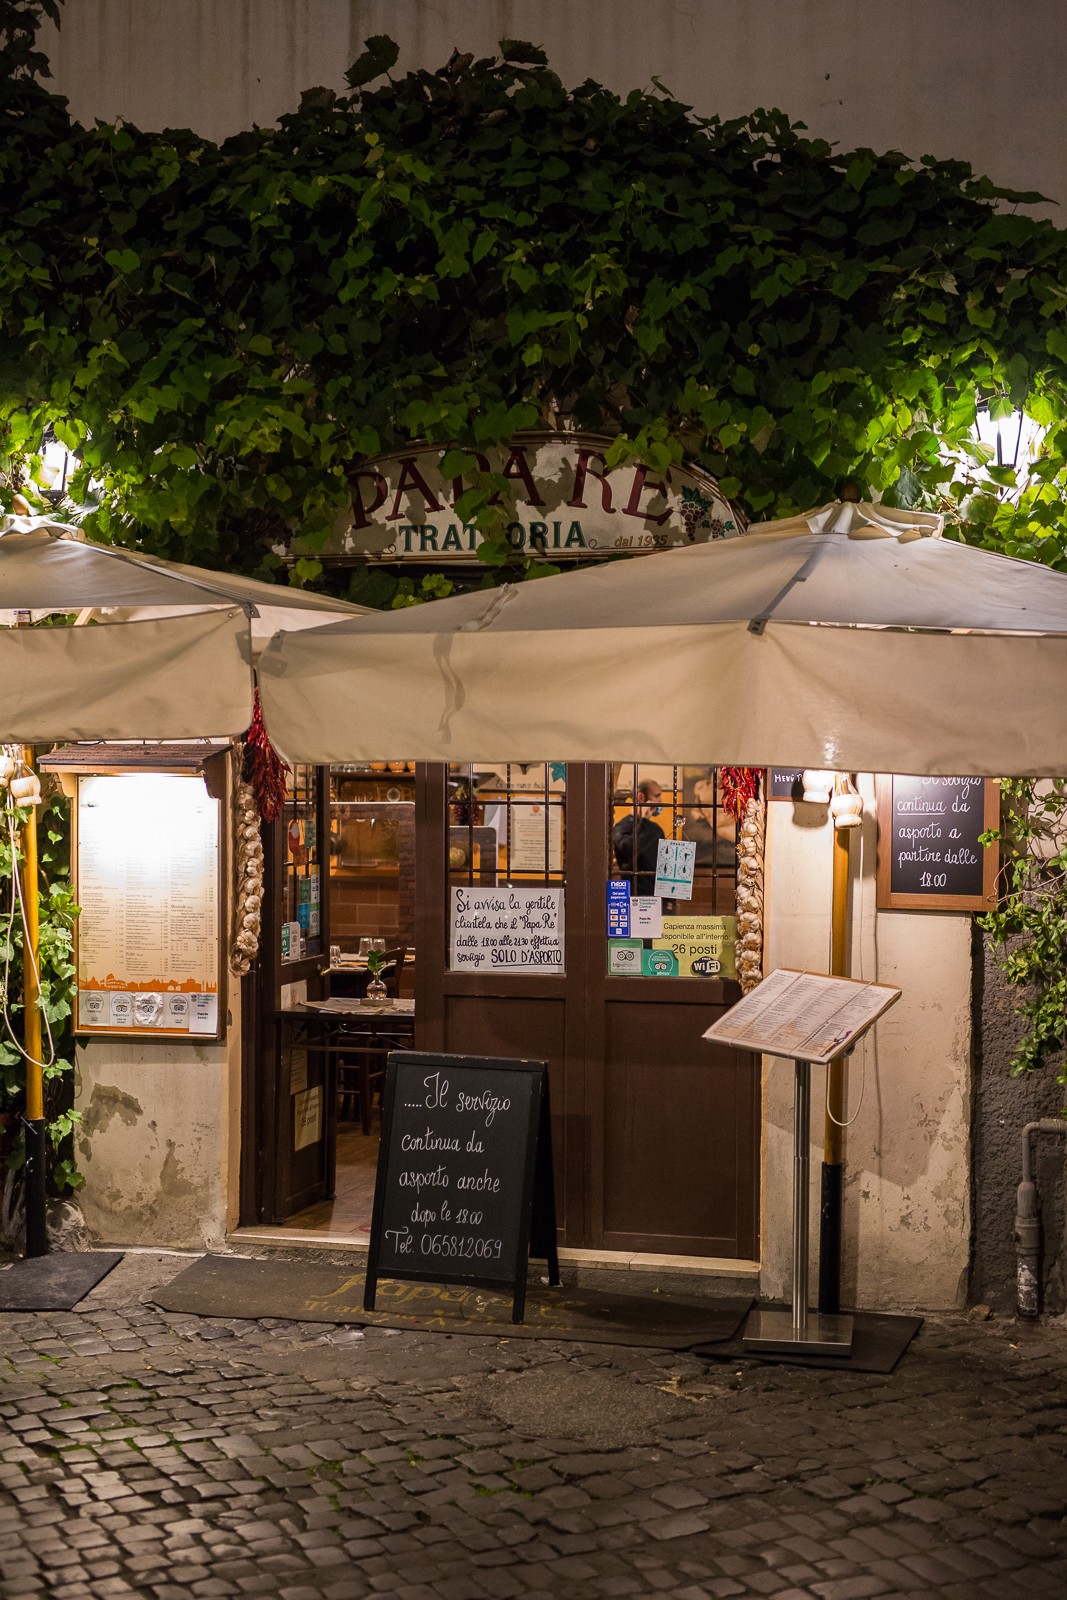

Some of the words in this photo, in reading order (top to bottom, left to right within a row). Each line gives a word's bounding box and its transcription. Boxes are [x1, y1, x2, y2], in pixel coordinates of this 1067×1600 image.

[398, 520, 590, 553] TRATORIA
[615, 535, 633, 547] dal
[637, 534, 668, 547] 1935
[896, 796, 947, 812] continua
[951, 795, 971, 813] da
[898, 822, 942, 848] asporto
[948, 827, 962, 840] a
[898, 846, 941, 869] partire
[944, 848, 978, 865] dalle
[456, 889, 471, 913] Si
[474, 896, 506, 911] avvisa
[509, 893, 521, 910] la
[526, 895, 556, 915] gentile
[455, 915, 492, 929] clientela
[495, 917, 508, 929] che
[510, 917, 518, 929] il
[663, 922, 695, 930] Capienza
[456, 934, 478, 947] dalle
[498, 934, 513, 947] alle
[530, 934, 559, 950] effettua
[661, 933, 695, 941] isponibile
[456, 951, 485, 967] servizio
[491, 948, 517, 963] SOLO
[521, 949, 562, 963] D'ASPORTO
[672, 943, 686, 954] 26
[690, 944, 717, 956] posti
[456, 1090, 511, 1127] servizio
[401, 1126, 461, 1151] continua
[466, 1130, 485, 1153] da
[399, 1165, 449, 1194] asporto
[457, 1168, 500, 1192] anche
[411, 1202, 436, 1228] dopo
[440, 1200, 451, 1221] le
[455, 1209, 483, 1225] 18.00
[384, 1226, 414, 1254] Tel.
[421, 1234, 502, 1259] 065812069
